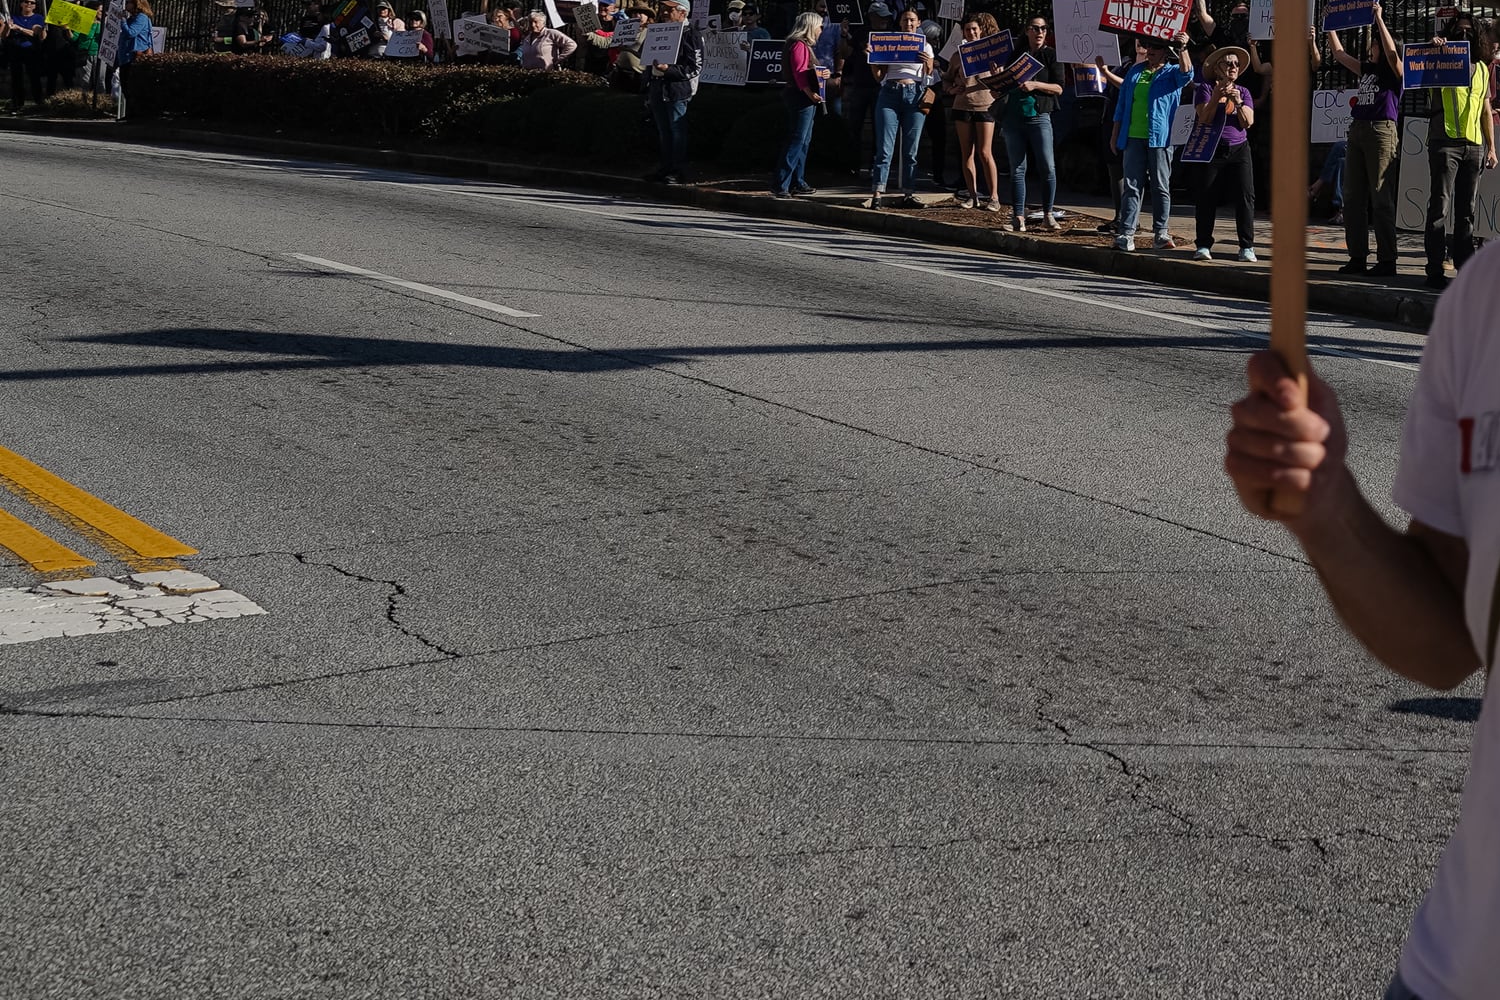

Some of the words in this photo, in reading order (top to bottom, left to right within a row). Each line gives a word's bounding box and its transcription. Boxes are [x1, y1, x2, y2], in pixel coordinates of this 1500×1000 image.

[836, 4, 850, 14] CDC
[1073, 0, 1090, 18] AI
[1160, 8, 1174, 17] NO
[1173, 4, 1184, 12] NO
[1109, 15, 1138, 31] SAVE
[872, 34, 902, 42] Government
[903, 34, 923, 43] Workers
[874, 44, 887, 52] Work
[961, 40, 990, 55] Government
[990, 34, 1009, 45] Workers
[706, 46, 739, 58] WORKERS
[753, 50, 783, 60] SAVE
[1405, 47, 1440, 56] Government
[1442, 45, 1467, 55] Workers
[966, 54, 980, 64] Work
[980, 52, 988, 60] for
[767, 64, 782, 73] CD
[1409, 61, 1424, 71] Work
[1425, 60, 1434, 70] for
[1436, 60, 1463, 70] America!
[1314, 92, 1344, 108] CDC
[1458, 417, 1475, 475] I
